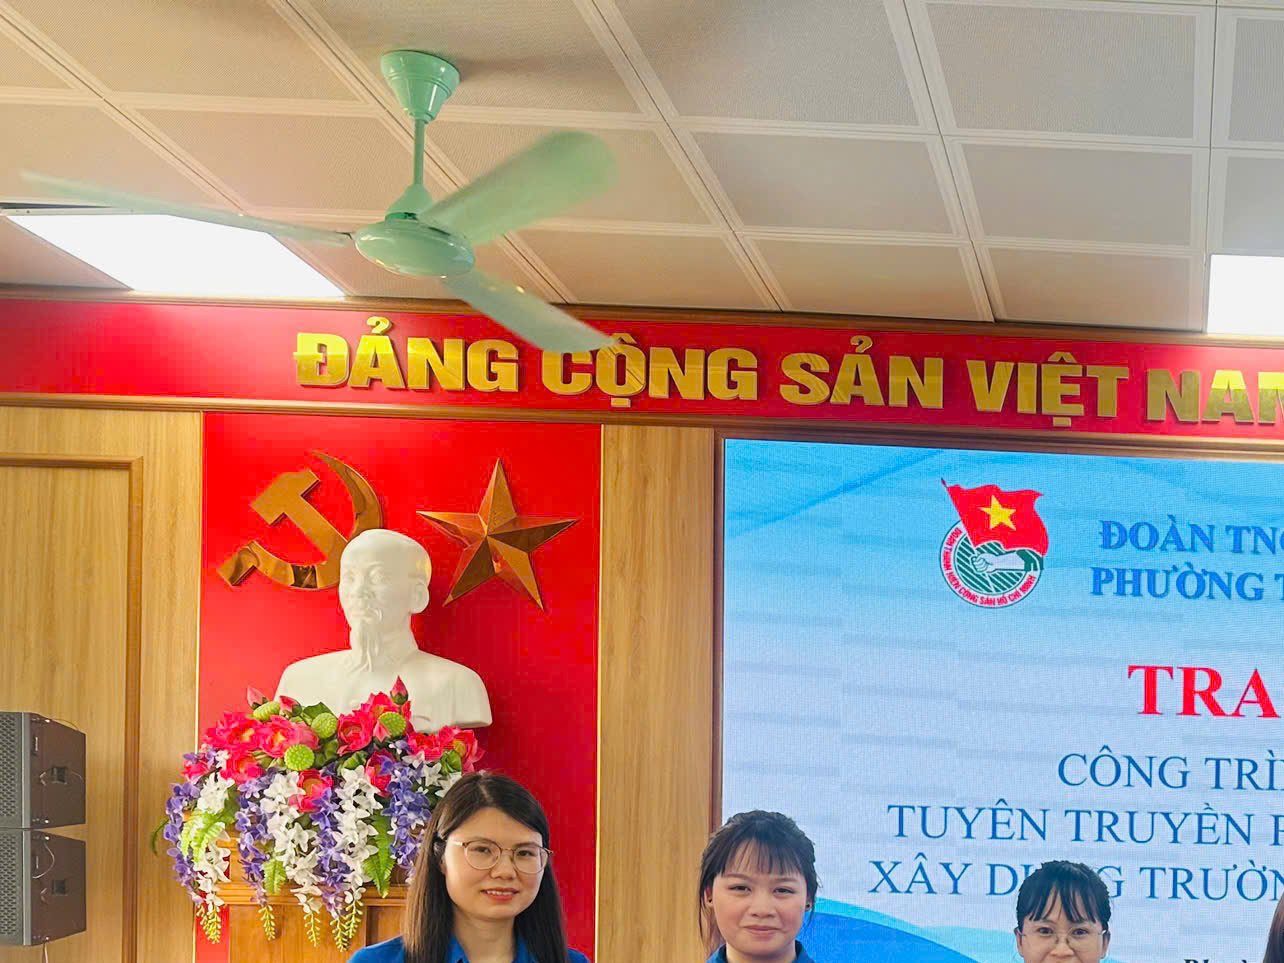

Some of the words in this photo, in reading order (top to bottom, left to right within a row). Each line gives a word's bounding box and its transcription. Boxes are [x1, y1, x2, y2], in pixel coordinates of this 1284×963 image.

[292, 315, 519, 393] ĐẢNG
[541, 332, 758, 408] CỘNG
[777, 333, 945, 409] SẢN
[965, 349, 1132, 428] VIỆT
[1099, 513, 1214, 555] ĐOÀN
[1089, 563, 1264, 602] PHƯỜNG
[1058, 745, 1190, 790] CÔNG
[888, 798, 1050, 842] TUYÊN
[1064, 802, 1253, 846] TRUYỀN
[868, 852, 973, 895] XÂY
